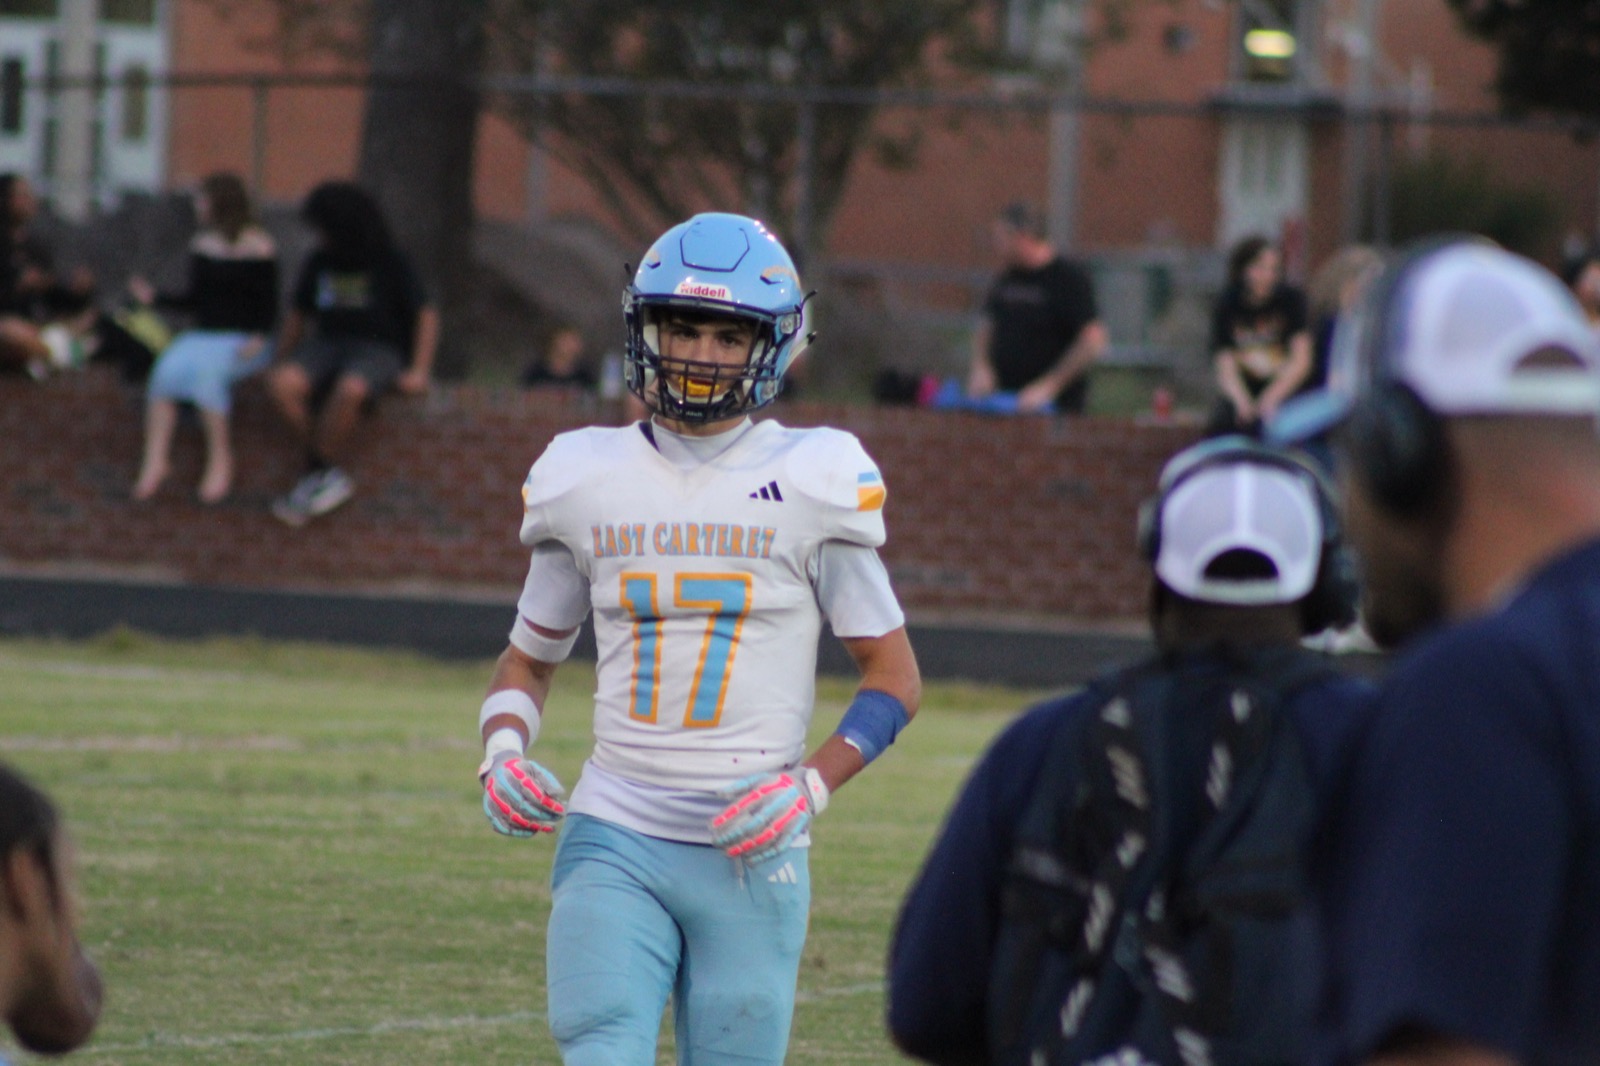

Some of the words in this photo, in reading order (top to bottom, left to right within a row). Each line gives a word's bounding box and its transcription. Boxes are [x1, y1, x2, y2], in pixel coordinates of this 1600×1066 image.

[680, 284, 726, 298] Riddell
[652, 522, 777, 559] CARTERET
[619, 571, 753, 728] 17
